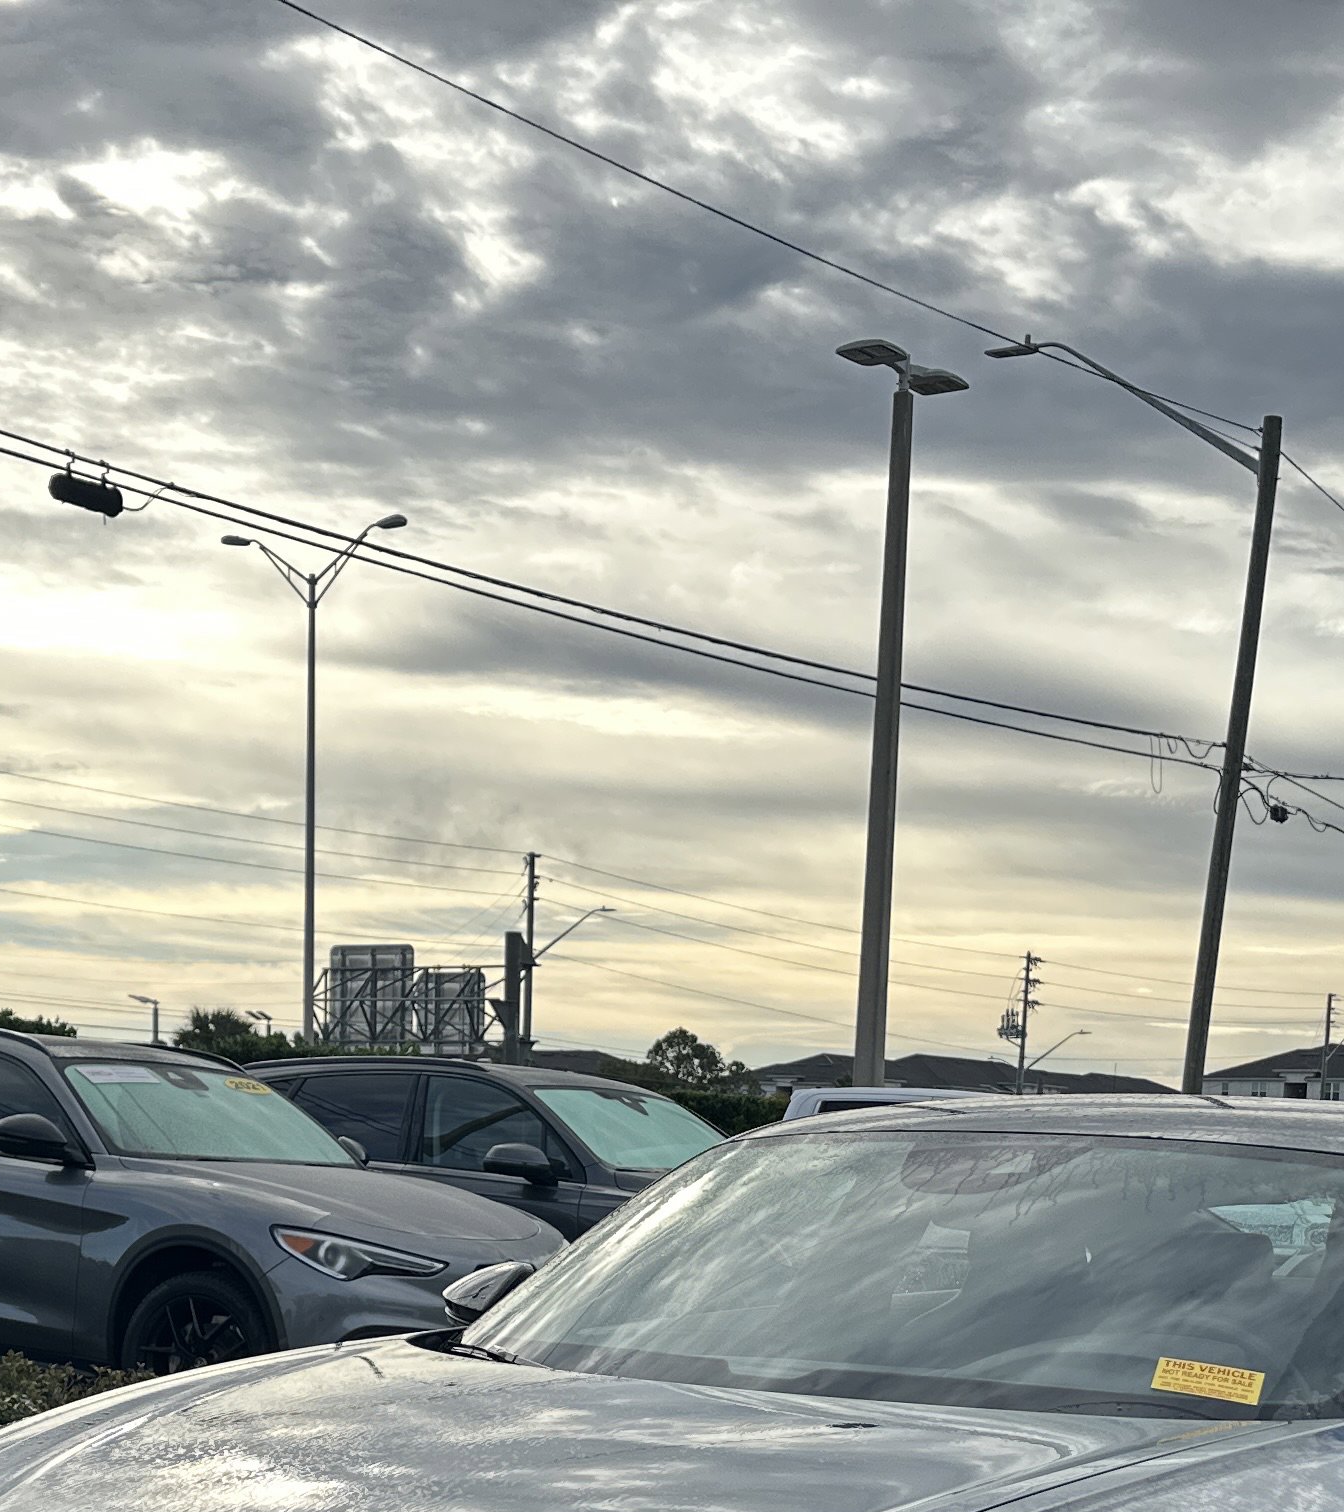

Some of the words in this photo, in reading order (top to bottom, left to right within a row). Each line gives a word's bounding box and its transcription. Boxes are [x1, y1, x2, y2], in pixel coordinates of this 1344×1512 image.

[1162, 1368, 1180, 1376] NOT
[1182, 1370, 1211, 1380] READY
[1212, 1375, 1230, 1384] FOR
[1232, 1379, 1254, 1388] SALE
[1165, 1360, 1195, 1370] THIS
[1200, 1365, 1257, 1380] VEHICLE
